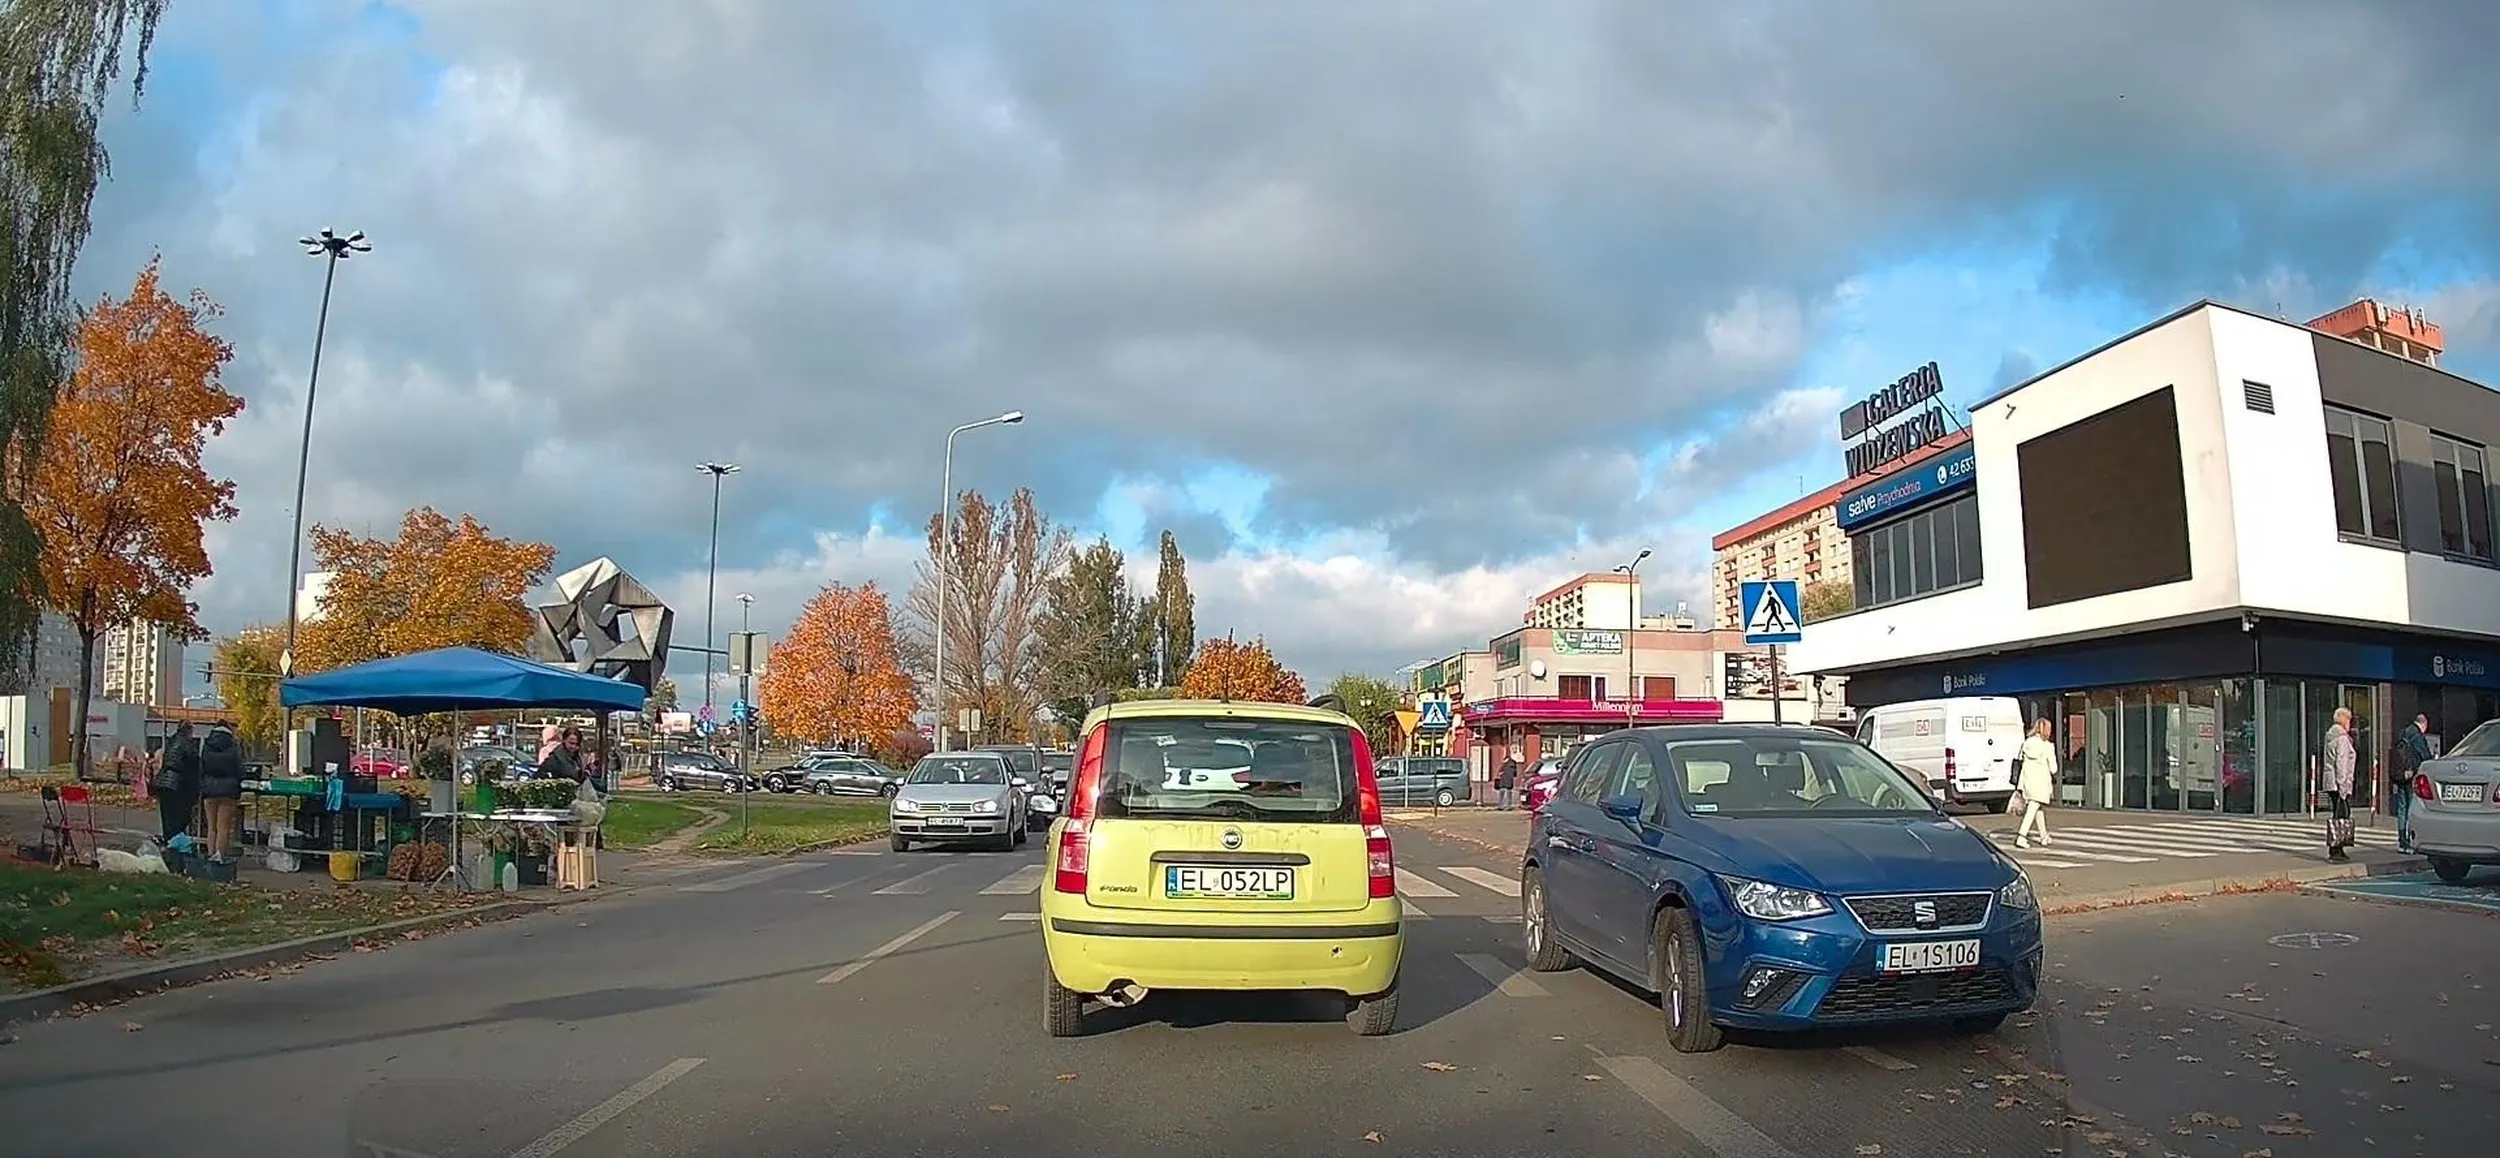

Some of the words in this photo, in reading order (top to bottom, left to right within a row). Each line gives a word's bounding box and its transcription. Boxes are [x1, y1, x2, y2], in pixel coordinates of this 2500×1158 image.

[1867, 361, 1944, 425] GALERIA
[1845, 406, 1947, 479] WIDZEWSKA
[1949, 461, 1960, 478] 42
[1848, 494, 1876, 518] salve
[1876, 480, 1922, 506] Przychodnia
[1181, 870, 1212, 891] EL
[1221, 870, 1289, 892] 052LP
[1889, 946, 1912, 968] EL
[1922, 941, 1977, 967] 1S106
